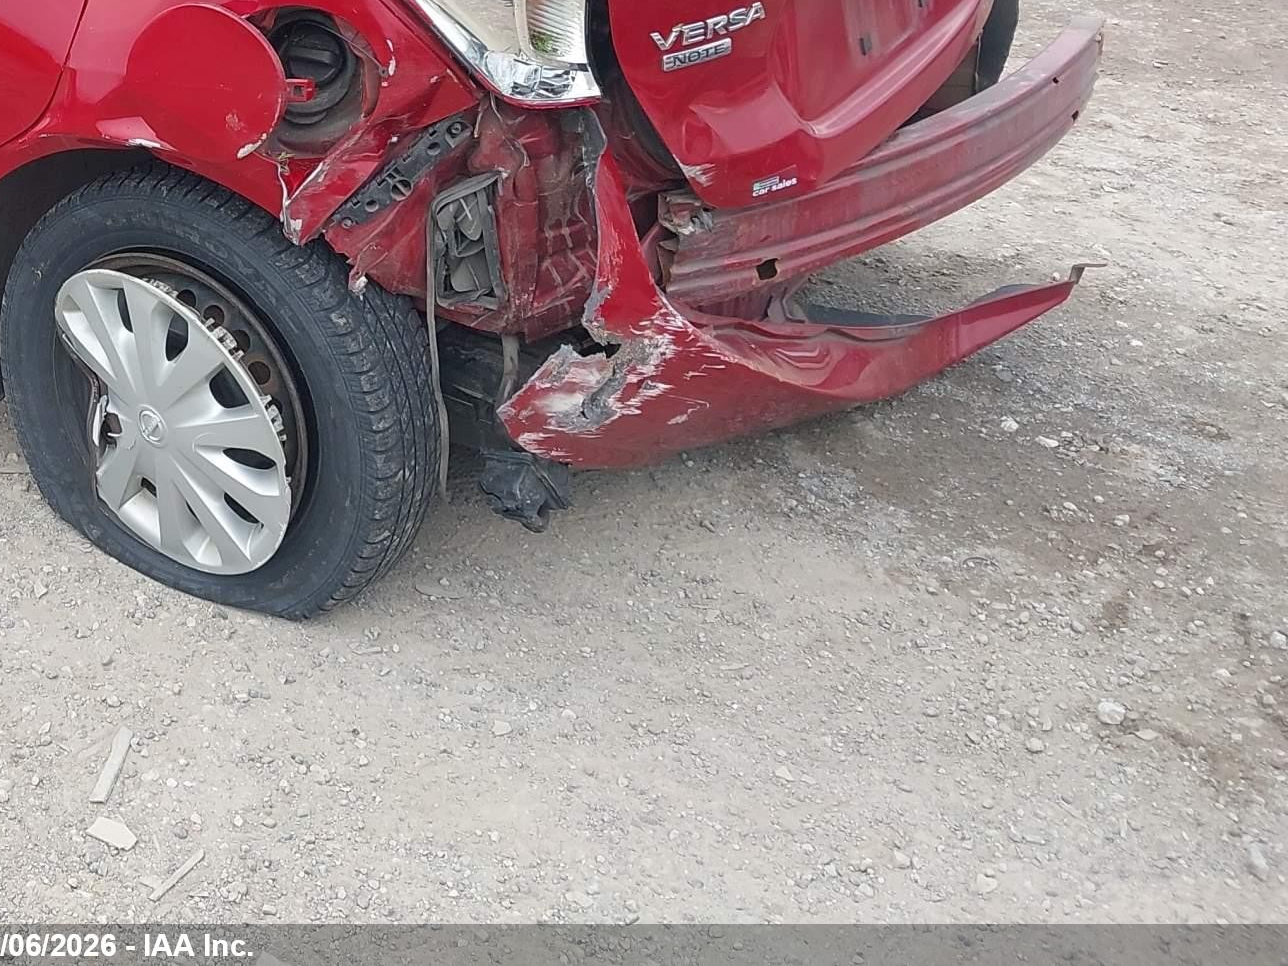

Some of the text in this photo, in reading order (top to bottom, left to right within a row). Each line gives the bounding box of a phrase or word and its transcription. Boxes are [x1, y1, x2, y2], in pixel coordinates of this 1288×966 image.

[650, 1, 766, 51] VERSA
[672, 41, 726, 69] NOTE
[752, 186, 770, 197] car
[771, 177, 798, 192] sales
